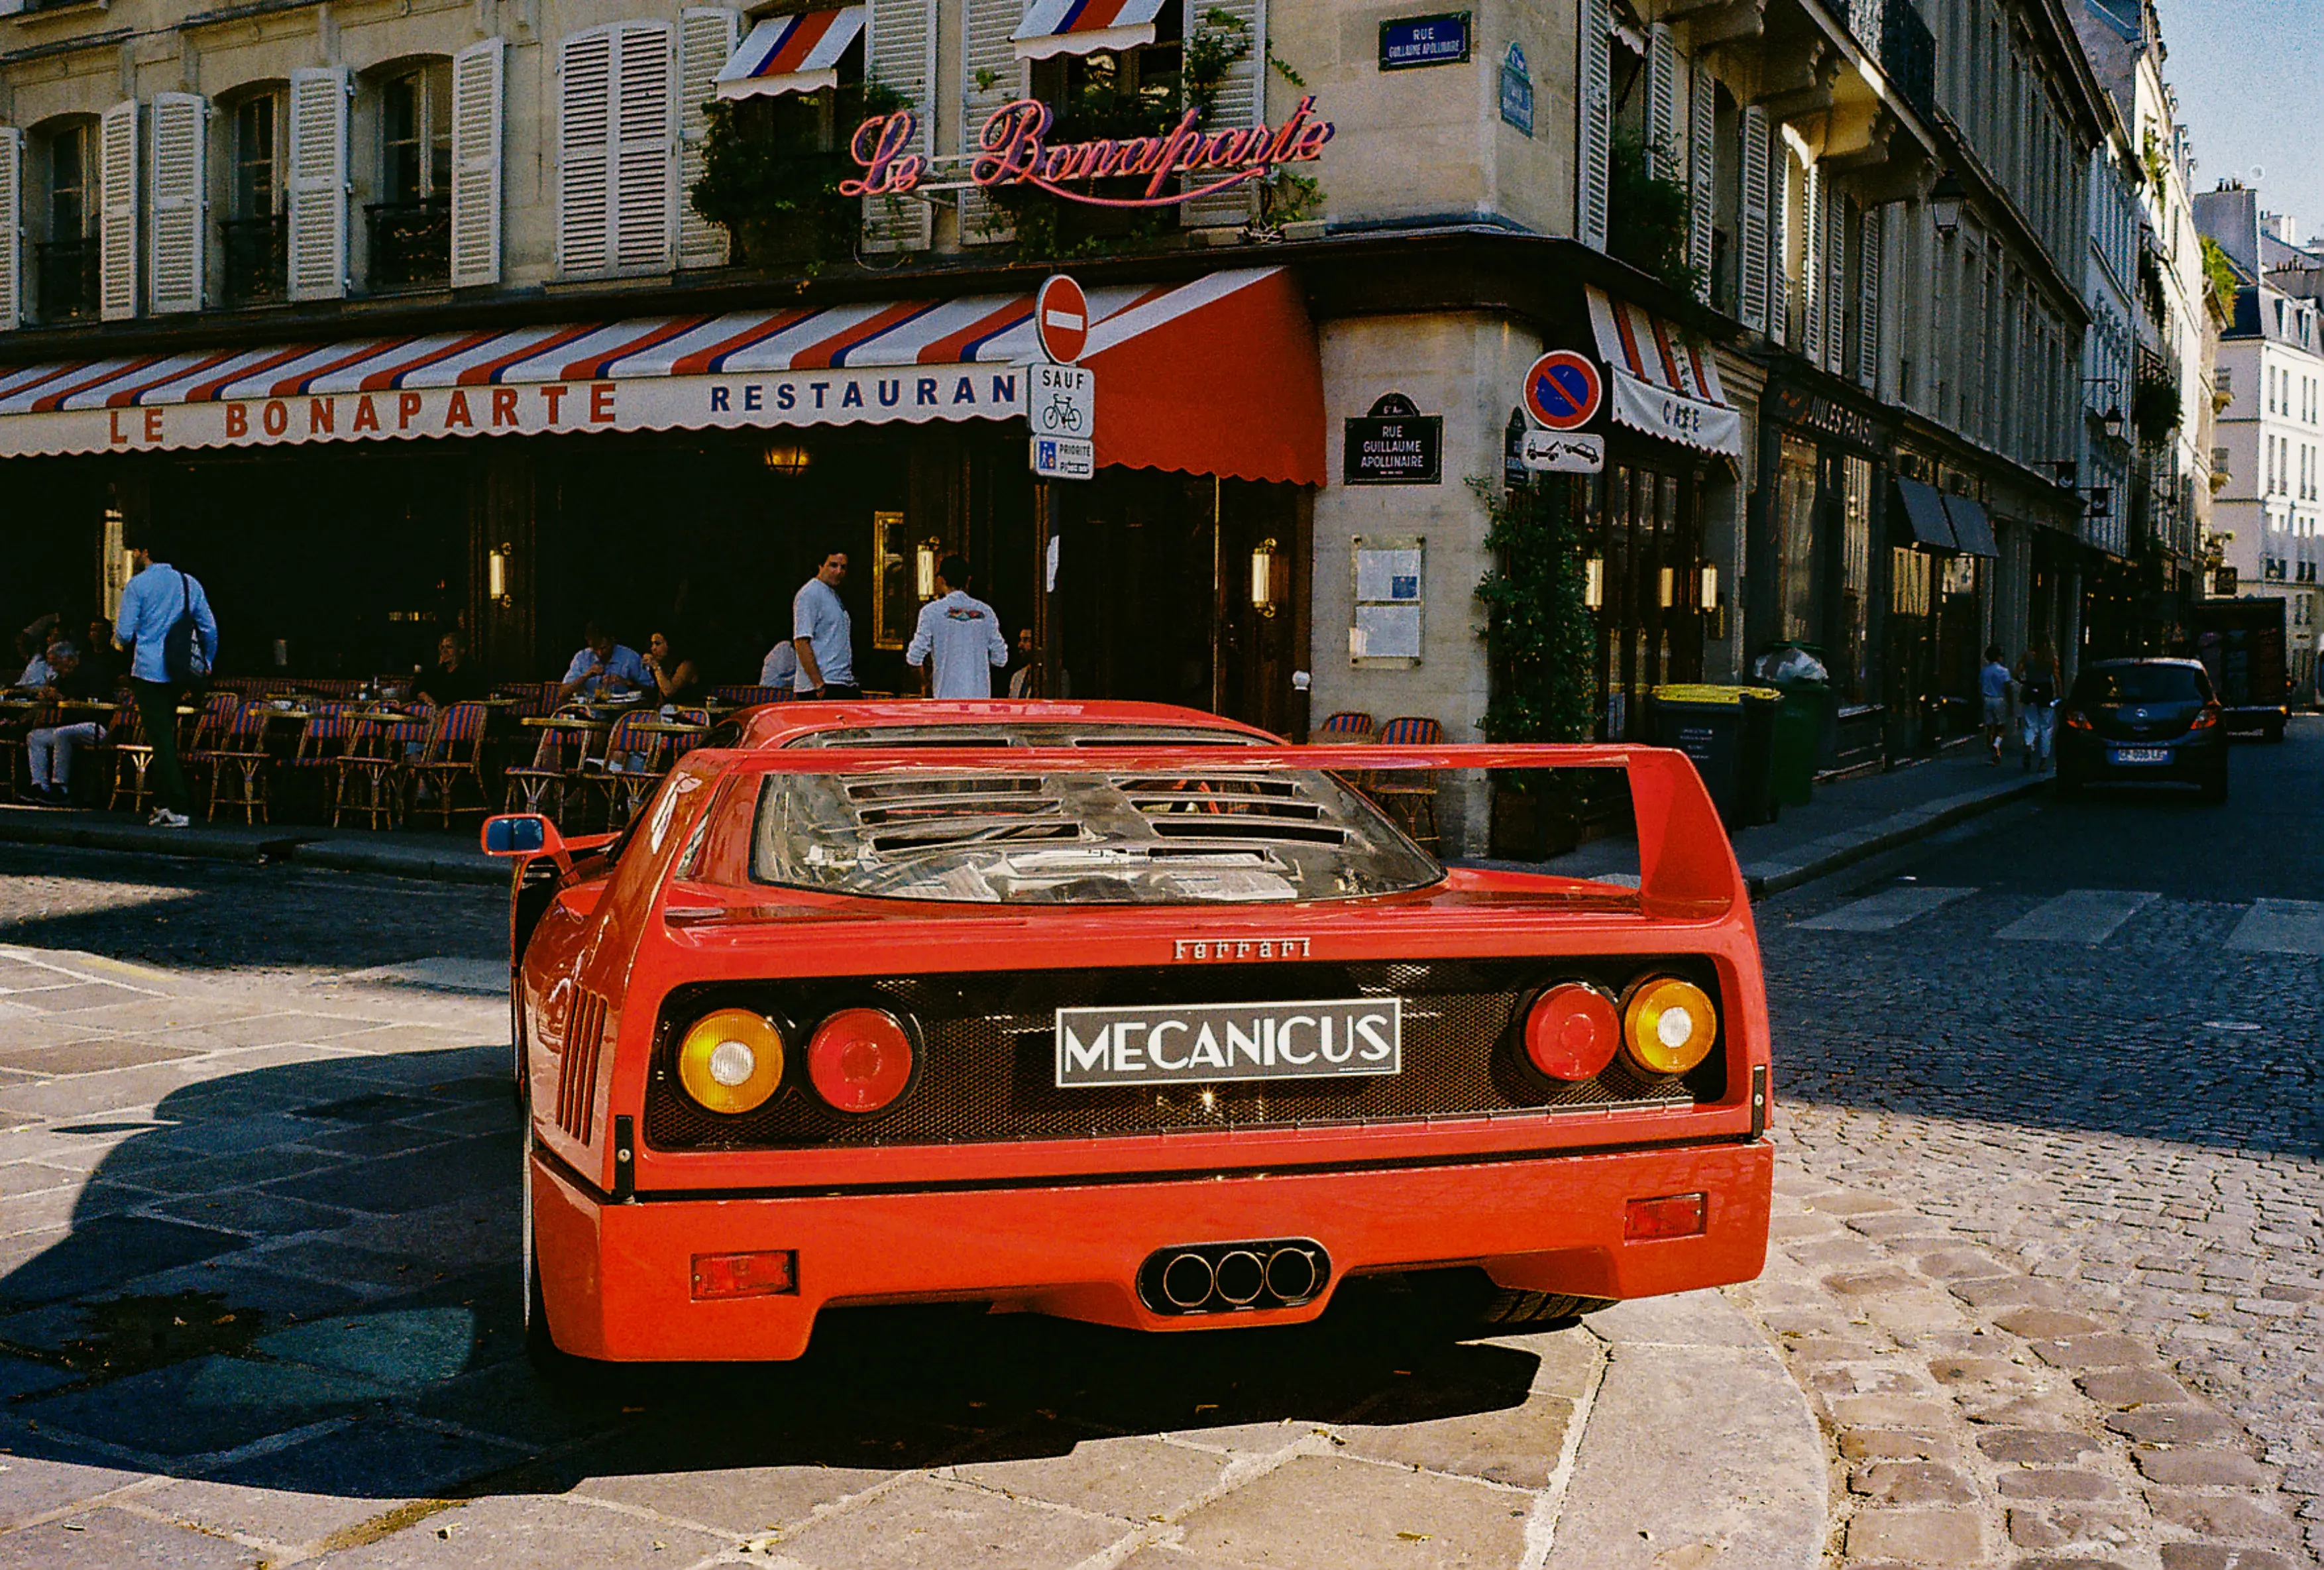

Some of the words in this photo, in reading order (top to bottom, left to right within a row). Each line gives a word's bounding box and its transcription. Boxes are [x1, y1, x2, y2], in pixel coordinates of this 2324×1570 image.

[1413, 27, 1435, 40] RUE
[1389, 44, 1421, 58] GUILLAUME
[838, 109, 926, 197] Le
[970, 94, 1335, 207] Bonaparte
[1042, 368, 1085, 390] SAUF
[109, 408, 165, 444] LE
[225, 382, 616, 438] BONAPARTE
[710, 374, 1017, 412] RESTAURAN
[1808, 396, 1843, 434] JULES
[1382, 425, 1403, 437] RUE
[1363, 440, 1421, 452] GUILLAUME
[1360, 455, 1423, 468] APOLLINAIRE
[1174, 937, 1311, 959] Ferrari
[1065, 1014, 1392, 1072] MECANICUS
